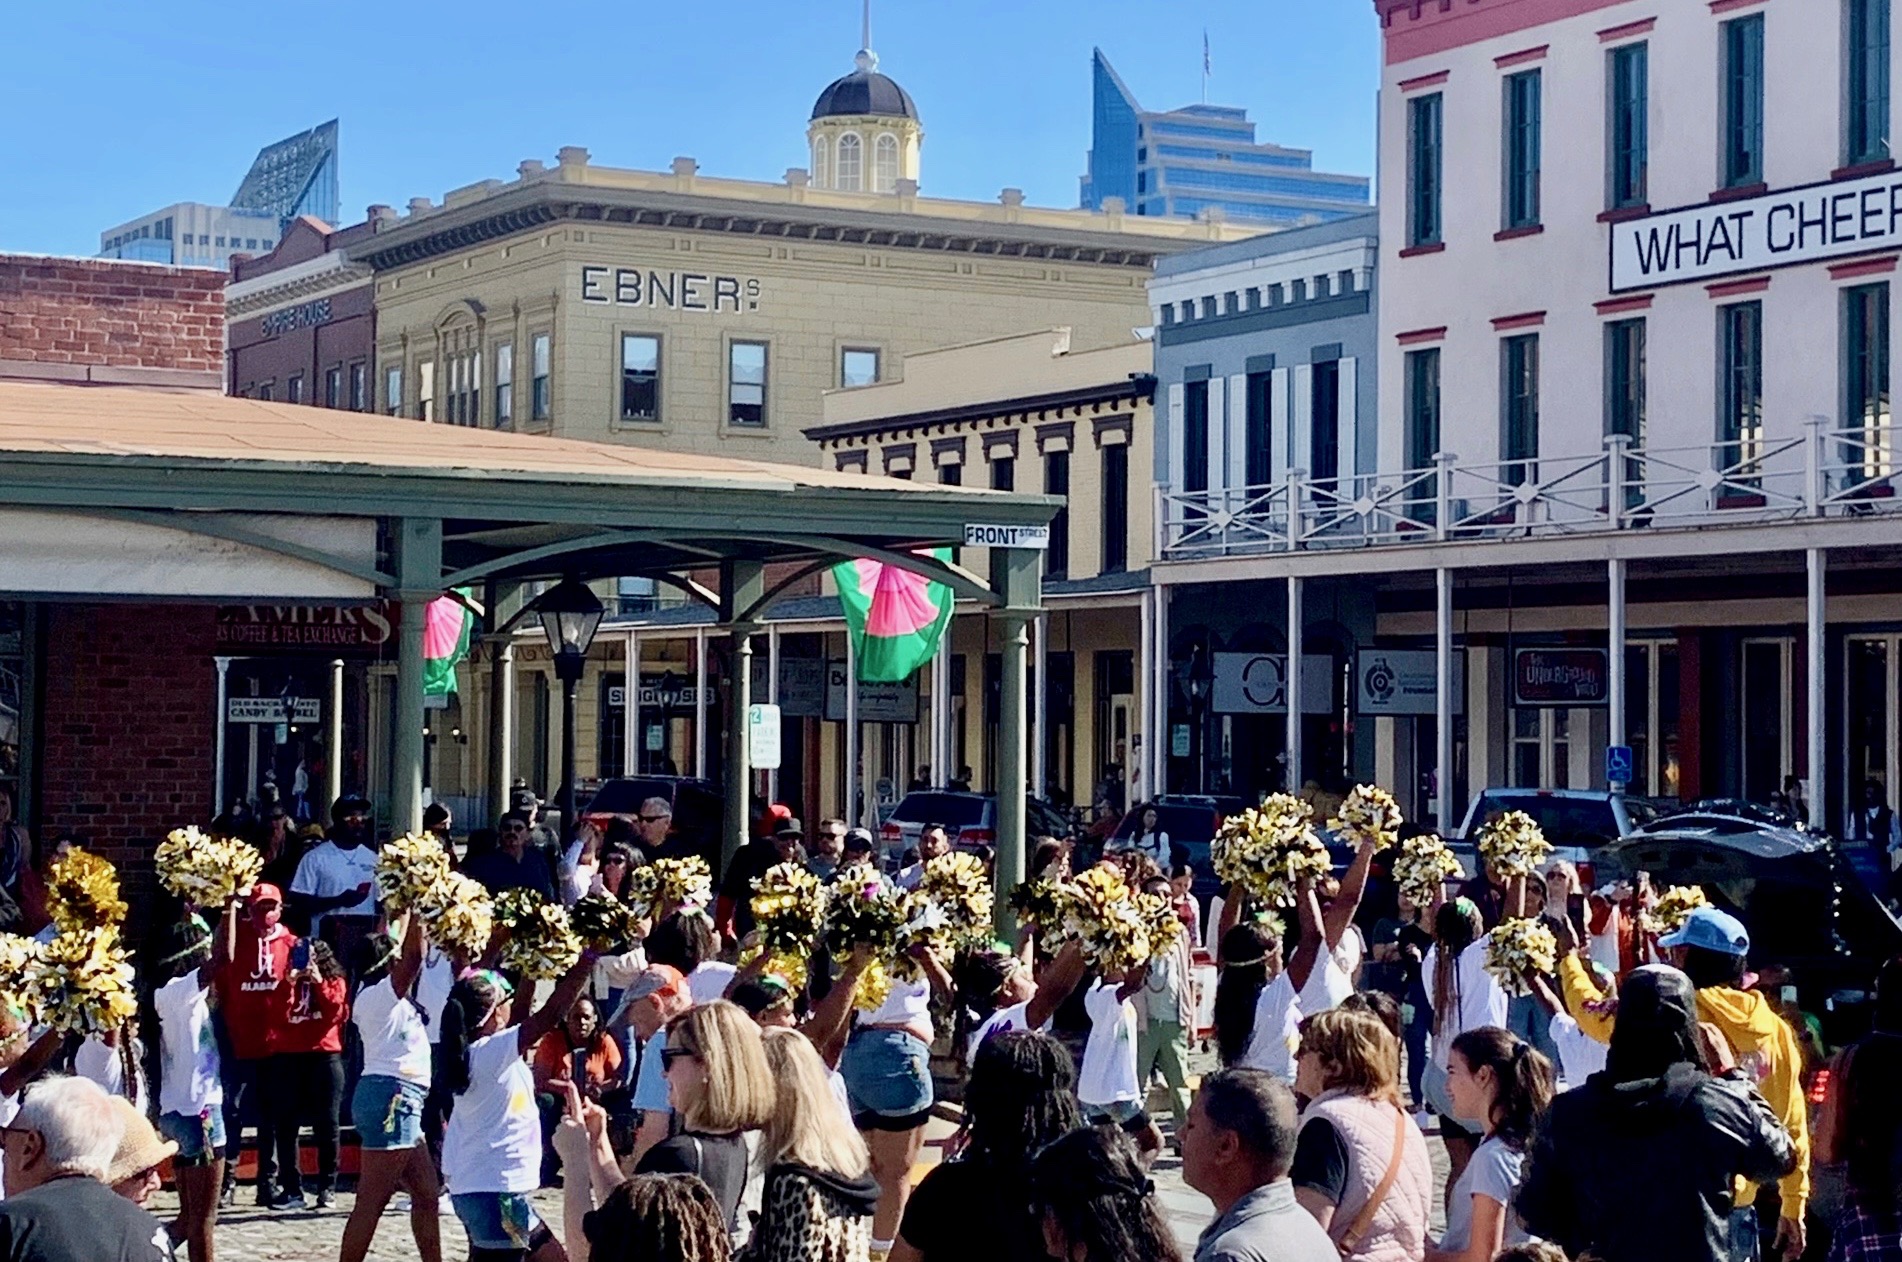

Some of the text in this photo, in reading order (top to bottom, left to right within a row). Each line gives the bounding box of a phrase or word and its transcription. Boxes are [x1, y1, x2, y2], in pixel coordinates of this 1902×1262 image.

[1634, 210, 1754, 275] WHAT
[966, 526, 1018, 545] FRONT
[230, 624, 269, 643] COFFEE
[271, 624, 279, 642] &
[281, 625, 301, 643] TEA
[304, 626, 358, 645] EXCHANGE
[230, 707, 268, 718] CANDY
[752, 706, 761, 723] 2
